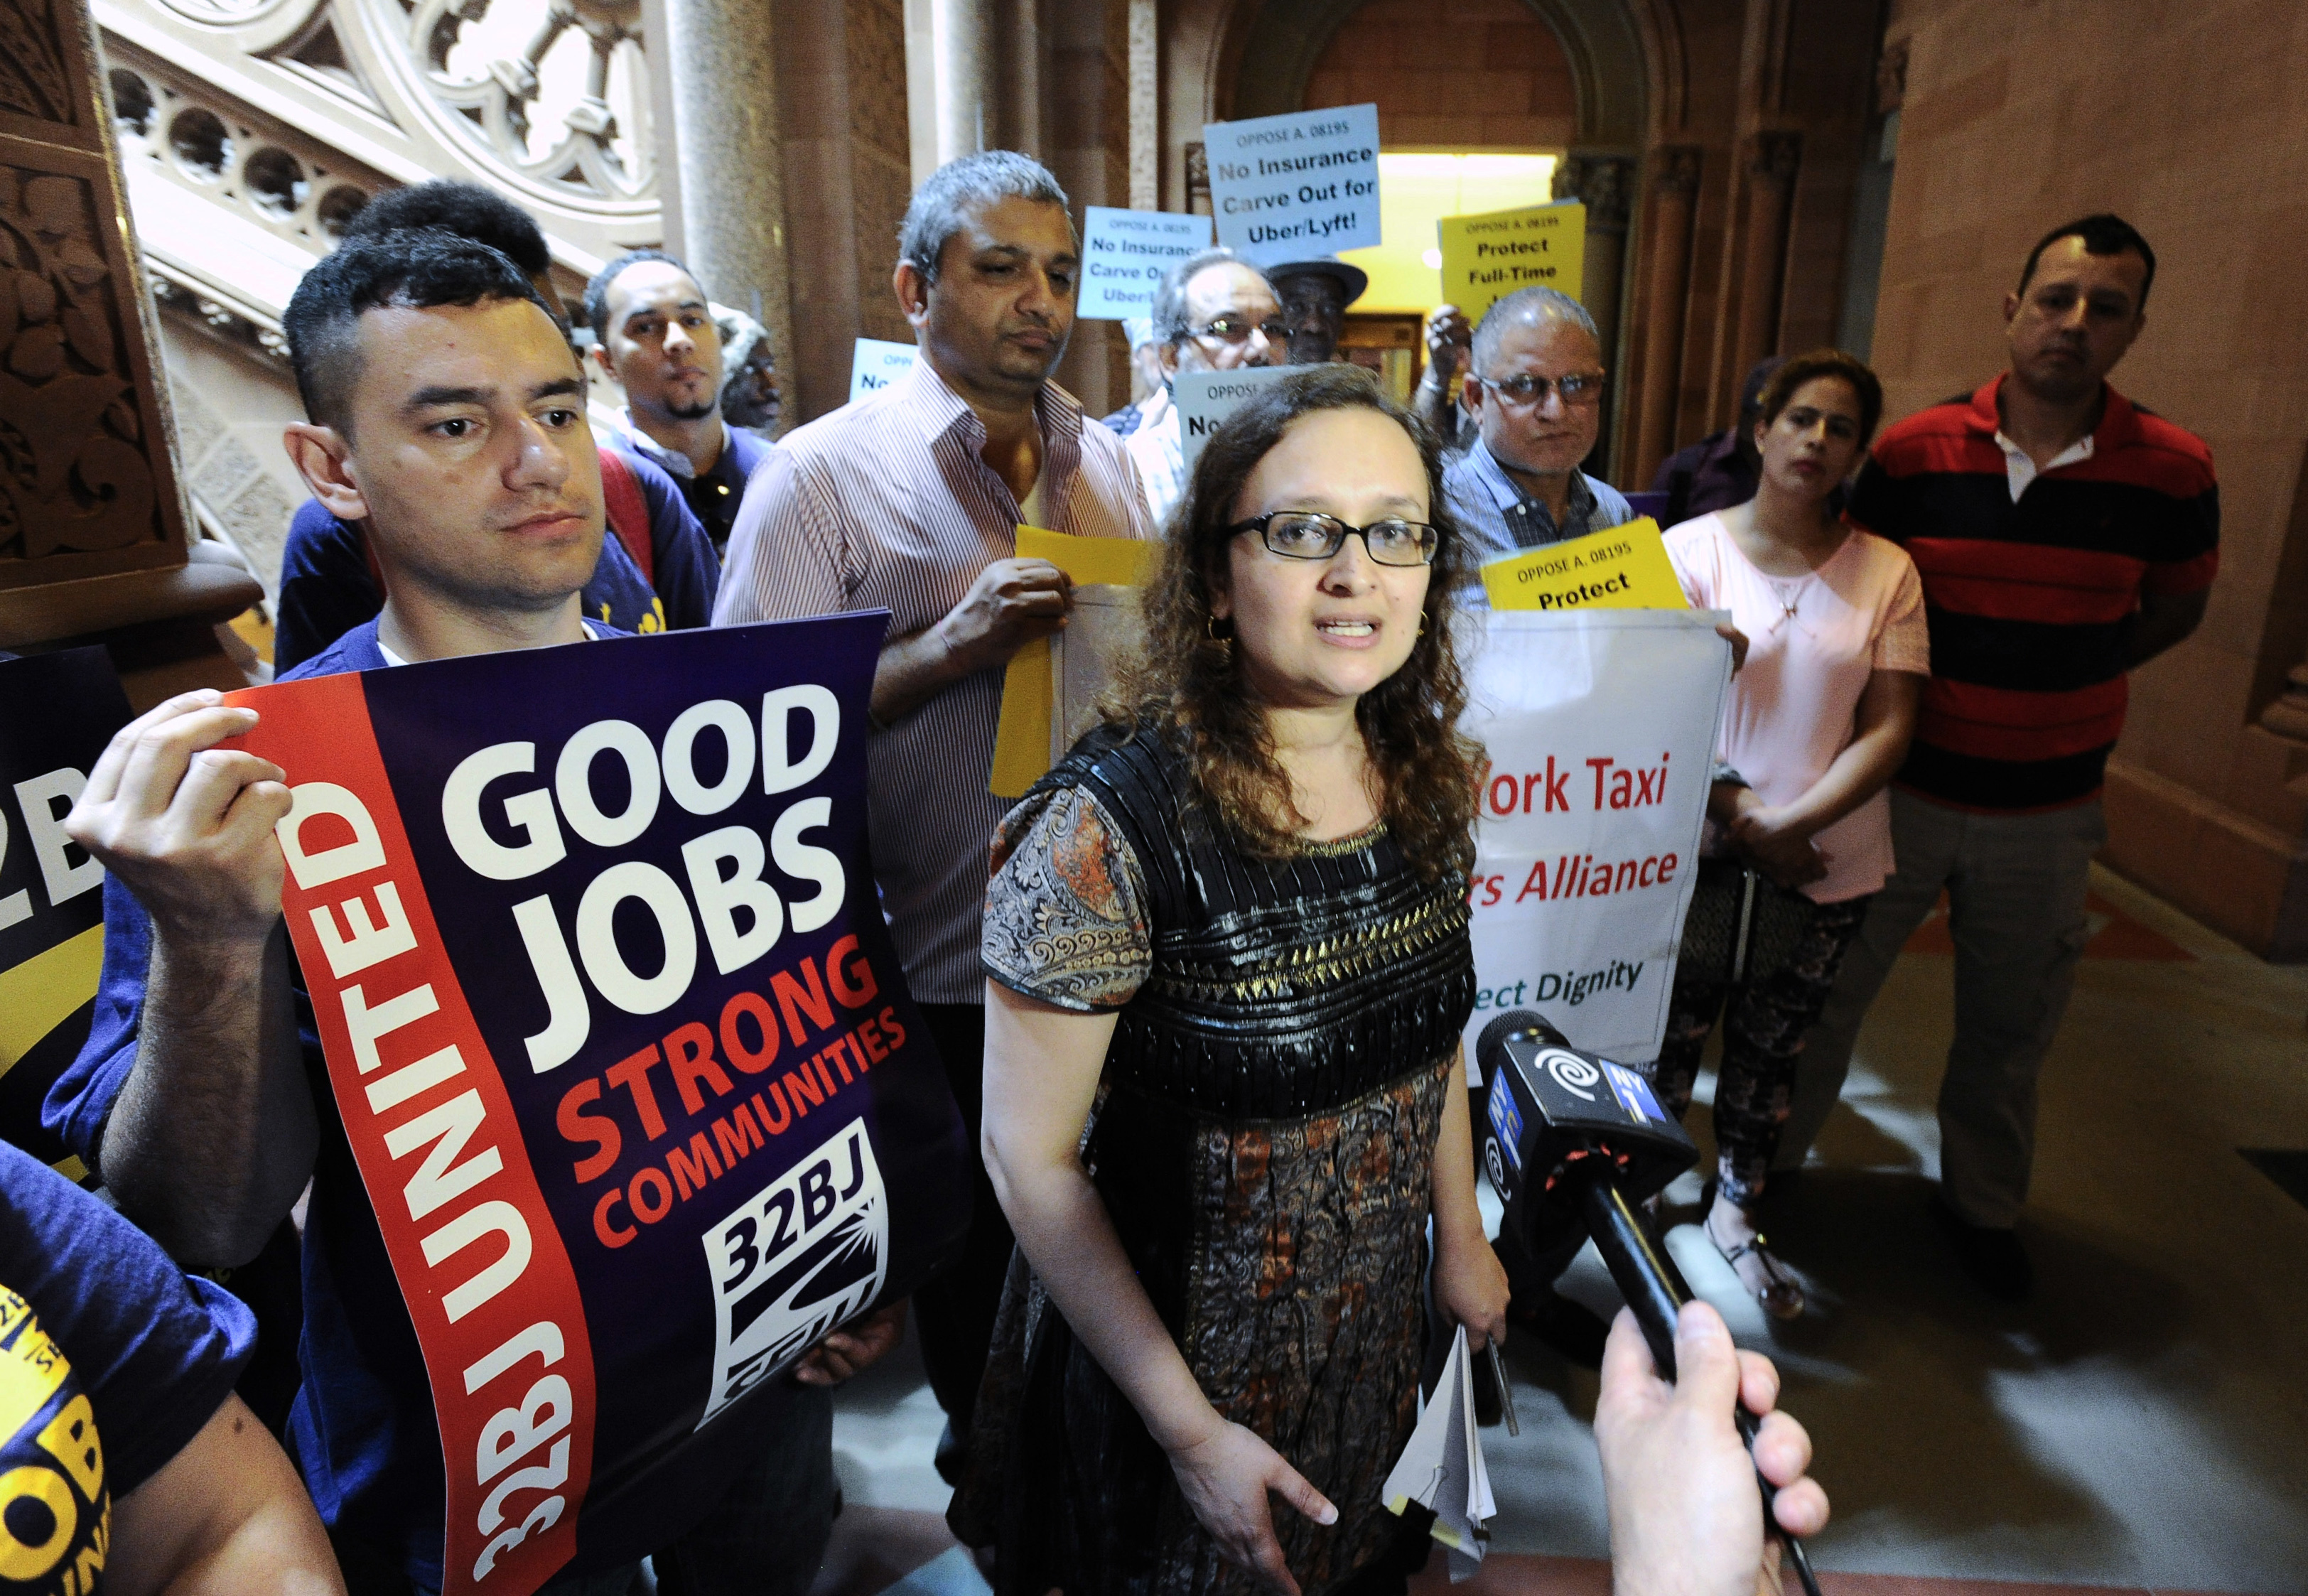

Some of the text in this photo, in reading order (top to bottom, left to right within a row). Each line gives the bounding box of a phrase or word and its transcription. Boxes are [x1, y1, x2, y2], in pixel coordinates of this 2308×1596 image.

[1236, 128, 1288, 147] OPPOSE
[1217, 147, 1372, 181] No Insurance
[1223, 179, 1374, 214] Carve Out for
[1092, 237, 1194, 257] No Insuranc
[1249, 212, 1357, 244] Uber/Lyft!
[1477, 239, 1548, 257] Protect
[1090, 263, 1140, 279] Carve
[1469, 266, 1557, 284] Full-Time
[1518, 559, 1569, 583] OPPOSE
[1590, 541, 1632, 564] 08195
[1539, 571, 1632, 610] Protect
[442, 684, 841, 880] GOOD
[1586, 751, 1671, 812] Taxi
[1516, 851, 1678, 903] Alliance
[512, 797, 846, 1074] JOBS
[1536, 959, 1644, 1006] Dignity
[556, 934, 878, 1184] STRONG
[593, 1006, 907, 1249] COMMUNITIES
[275, 782, 573, 1582] 32BJ UNITED
[723, 1130, 865, 1296] 32BJ
